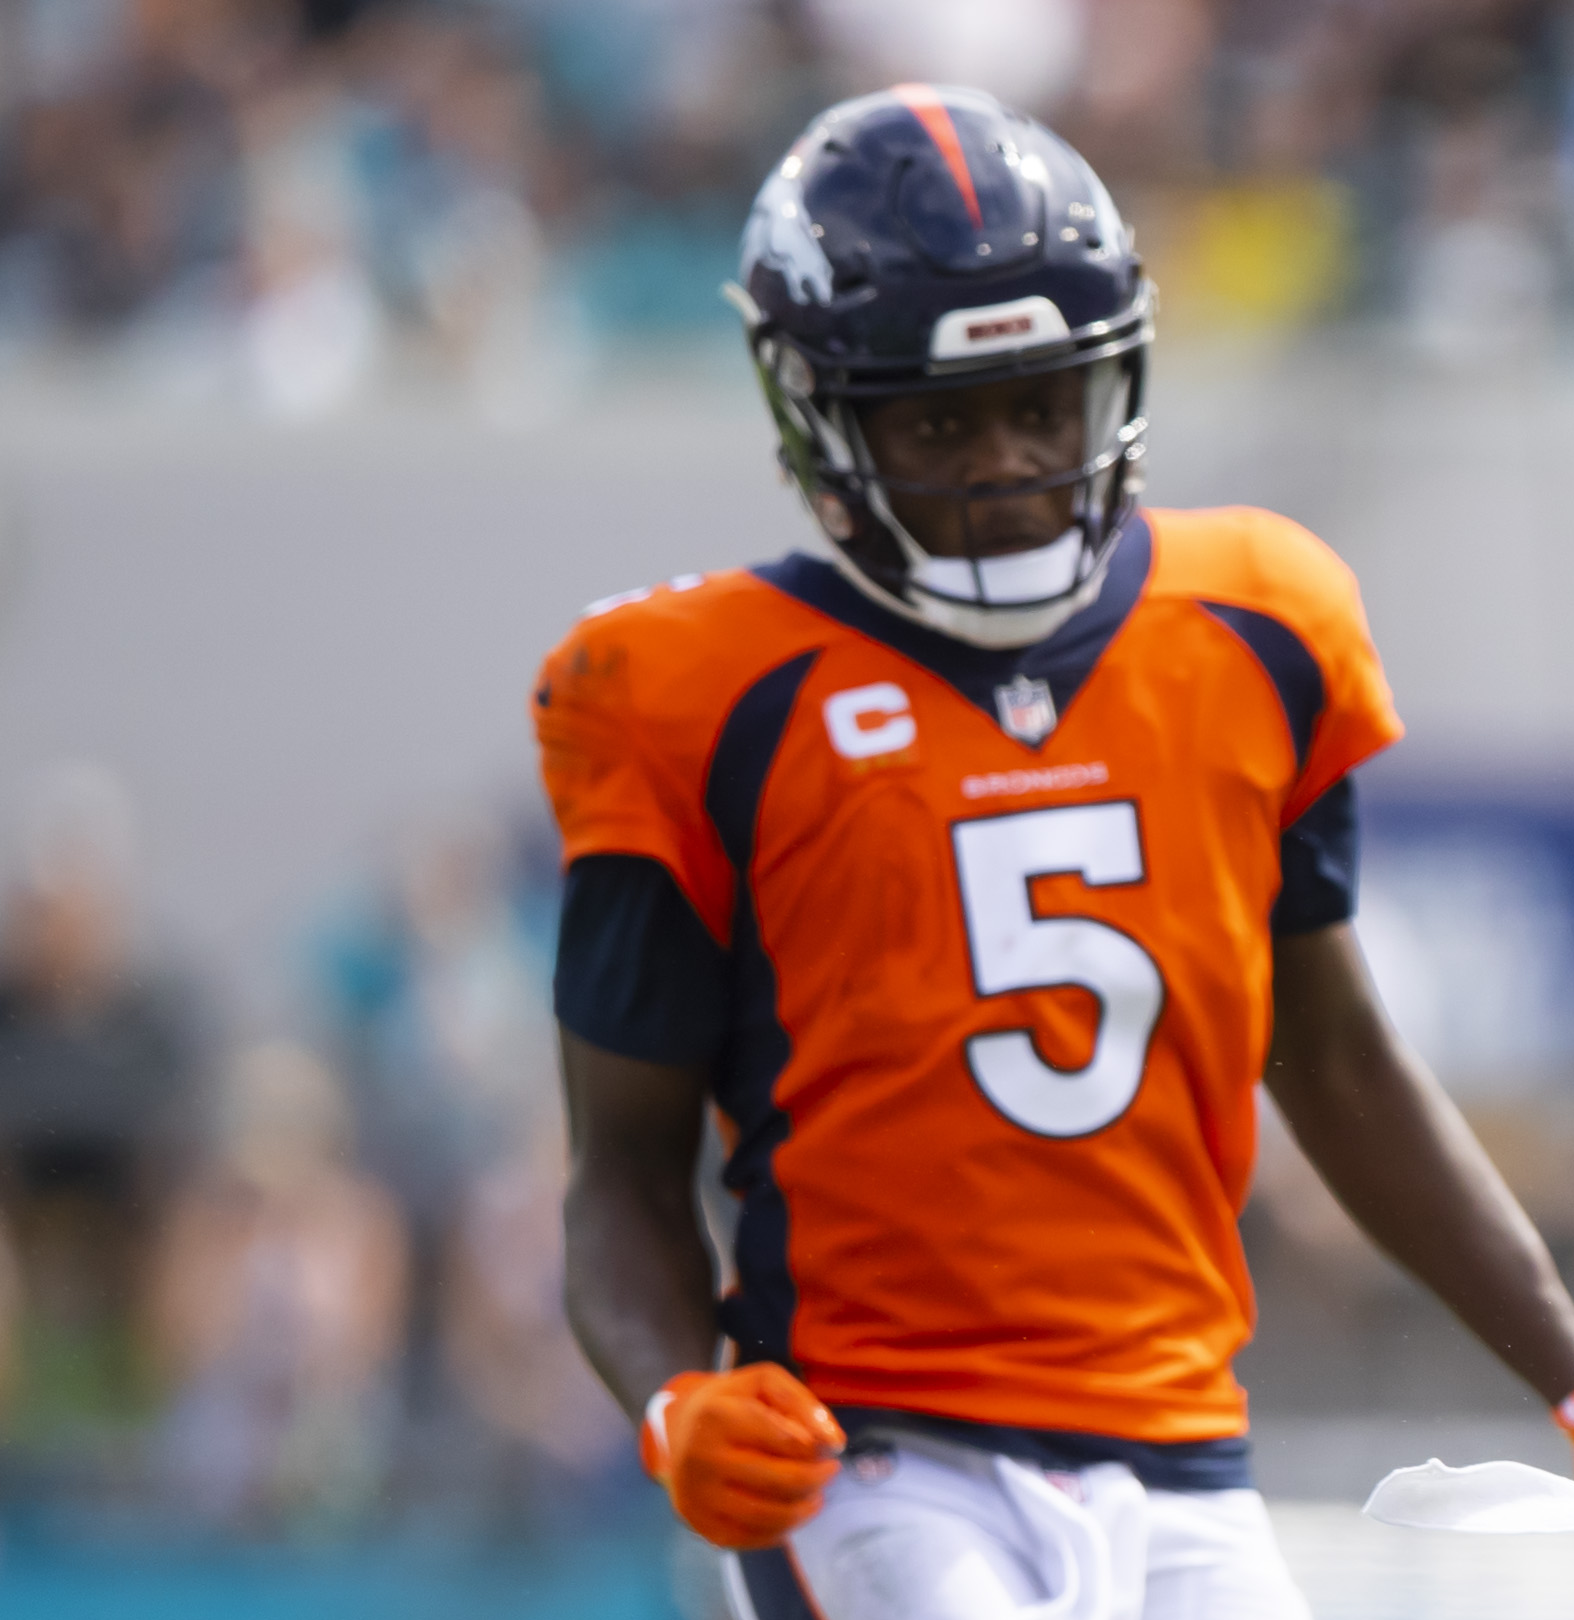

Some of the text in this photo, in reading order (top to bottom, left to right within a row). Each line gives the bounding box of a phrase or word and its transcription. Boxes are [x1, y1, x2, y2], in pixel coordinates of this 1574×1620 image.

[822, 681, 917, 759] C
[960, 761, 1110, 799] BRONCOS
[950, 798, 1166, 1139] 5
